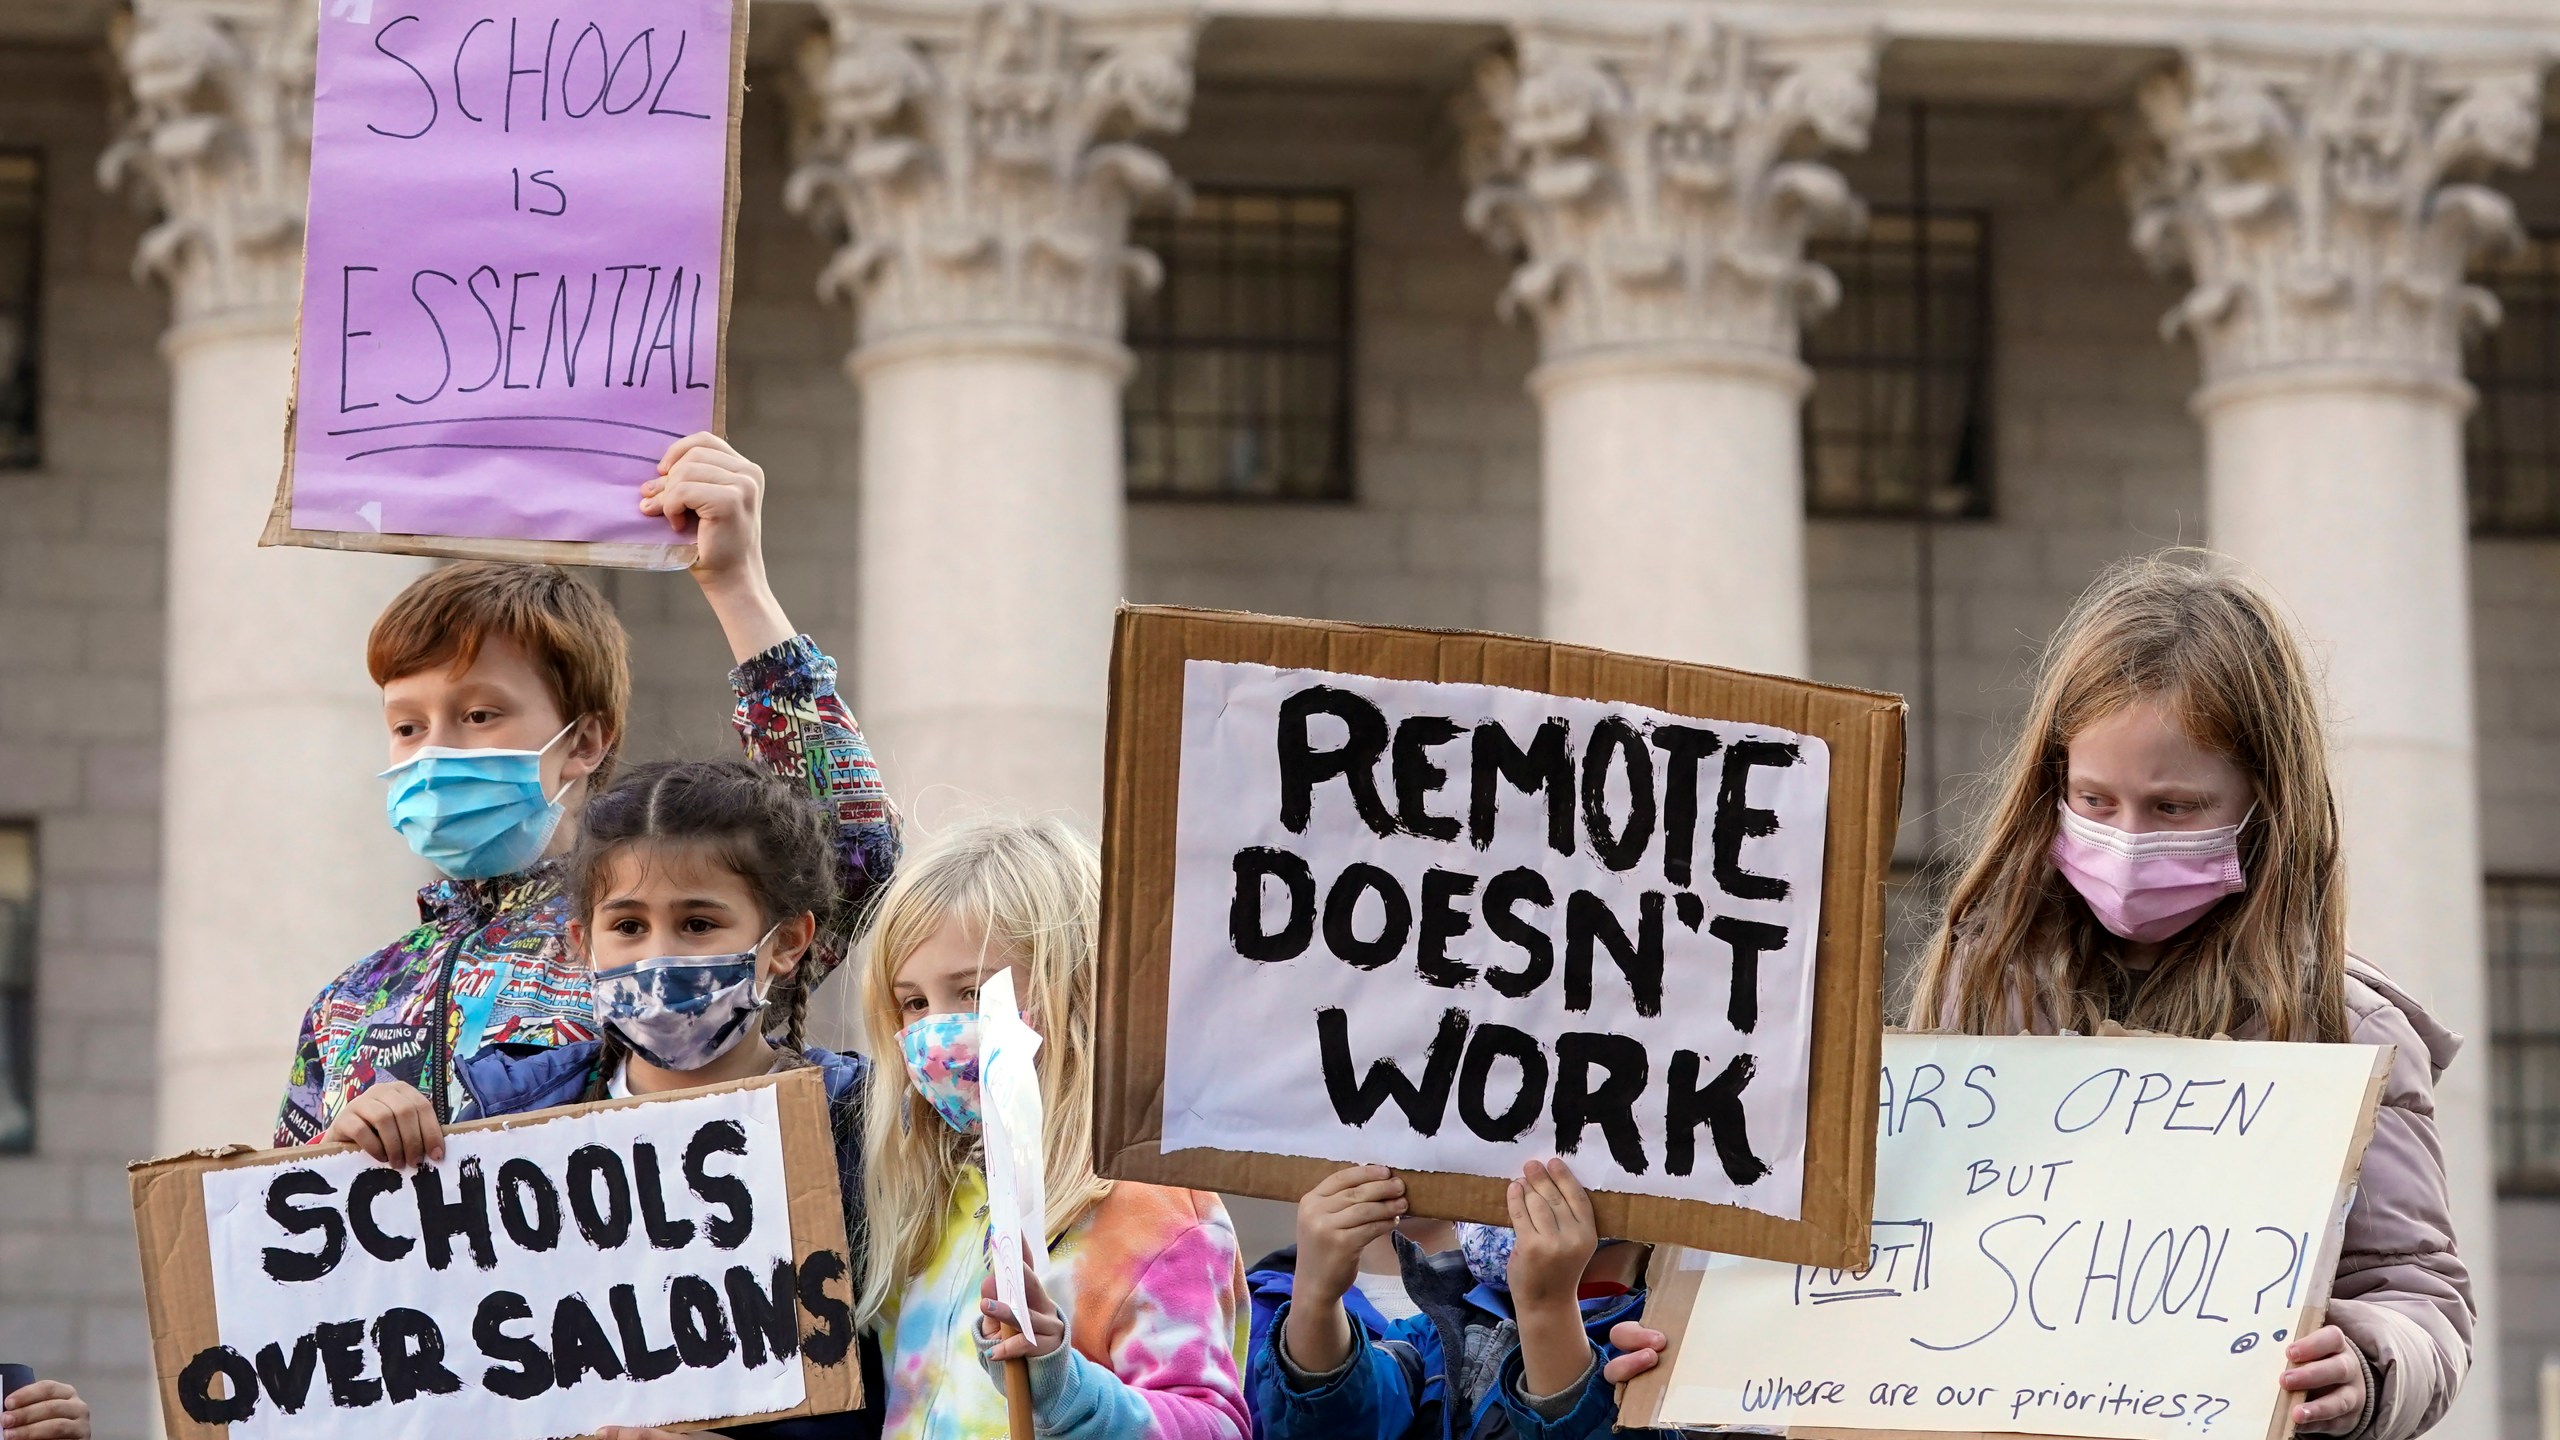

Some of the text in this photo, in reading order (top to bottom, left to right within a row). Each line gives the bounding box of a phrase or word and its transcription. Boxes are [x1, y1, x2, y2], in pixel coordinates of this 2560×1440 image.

[367, 16, 711, 139] SCHOOL
[512, 168, 566, 216] IS
[340, 264, 709, 413] ESSENTIAL
[1278, 683, 1806, 901] REMOTE
[512, 960, 592, 990] CAPTA
[1229, 845, 1789, 1033] DOESN'T
[370, 1028, 411, 1040] AMAZING
[500, 980, 593, 1010] AMERIC
[1315, 1007, 1771, 1186] WORK
[1881, 1064, 2274, 1136] ARS OPEN
[261, 1118, 753, 1281] SCHOOLS
[1967, 1159, 2073, 1201] BUT
[178, 1249, 854, 1424] OVER SALONS
[1870, 1383, 1918, 1406] are
[1937, 1386, 1997, 1406] our
[2011, 1382, 2230, 1433] priorities??
